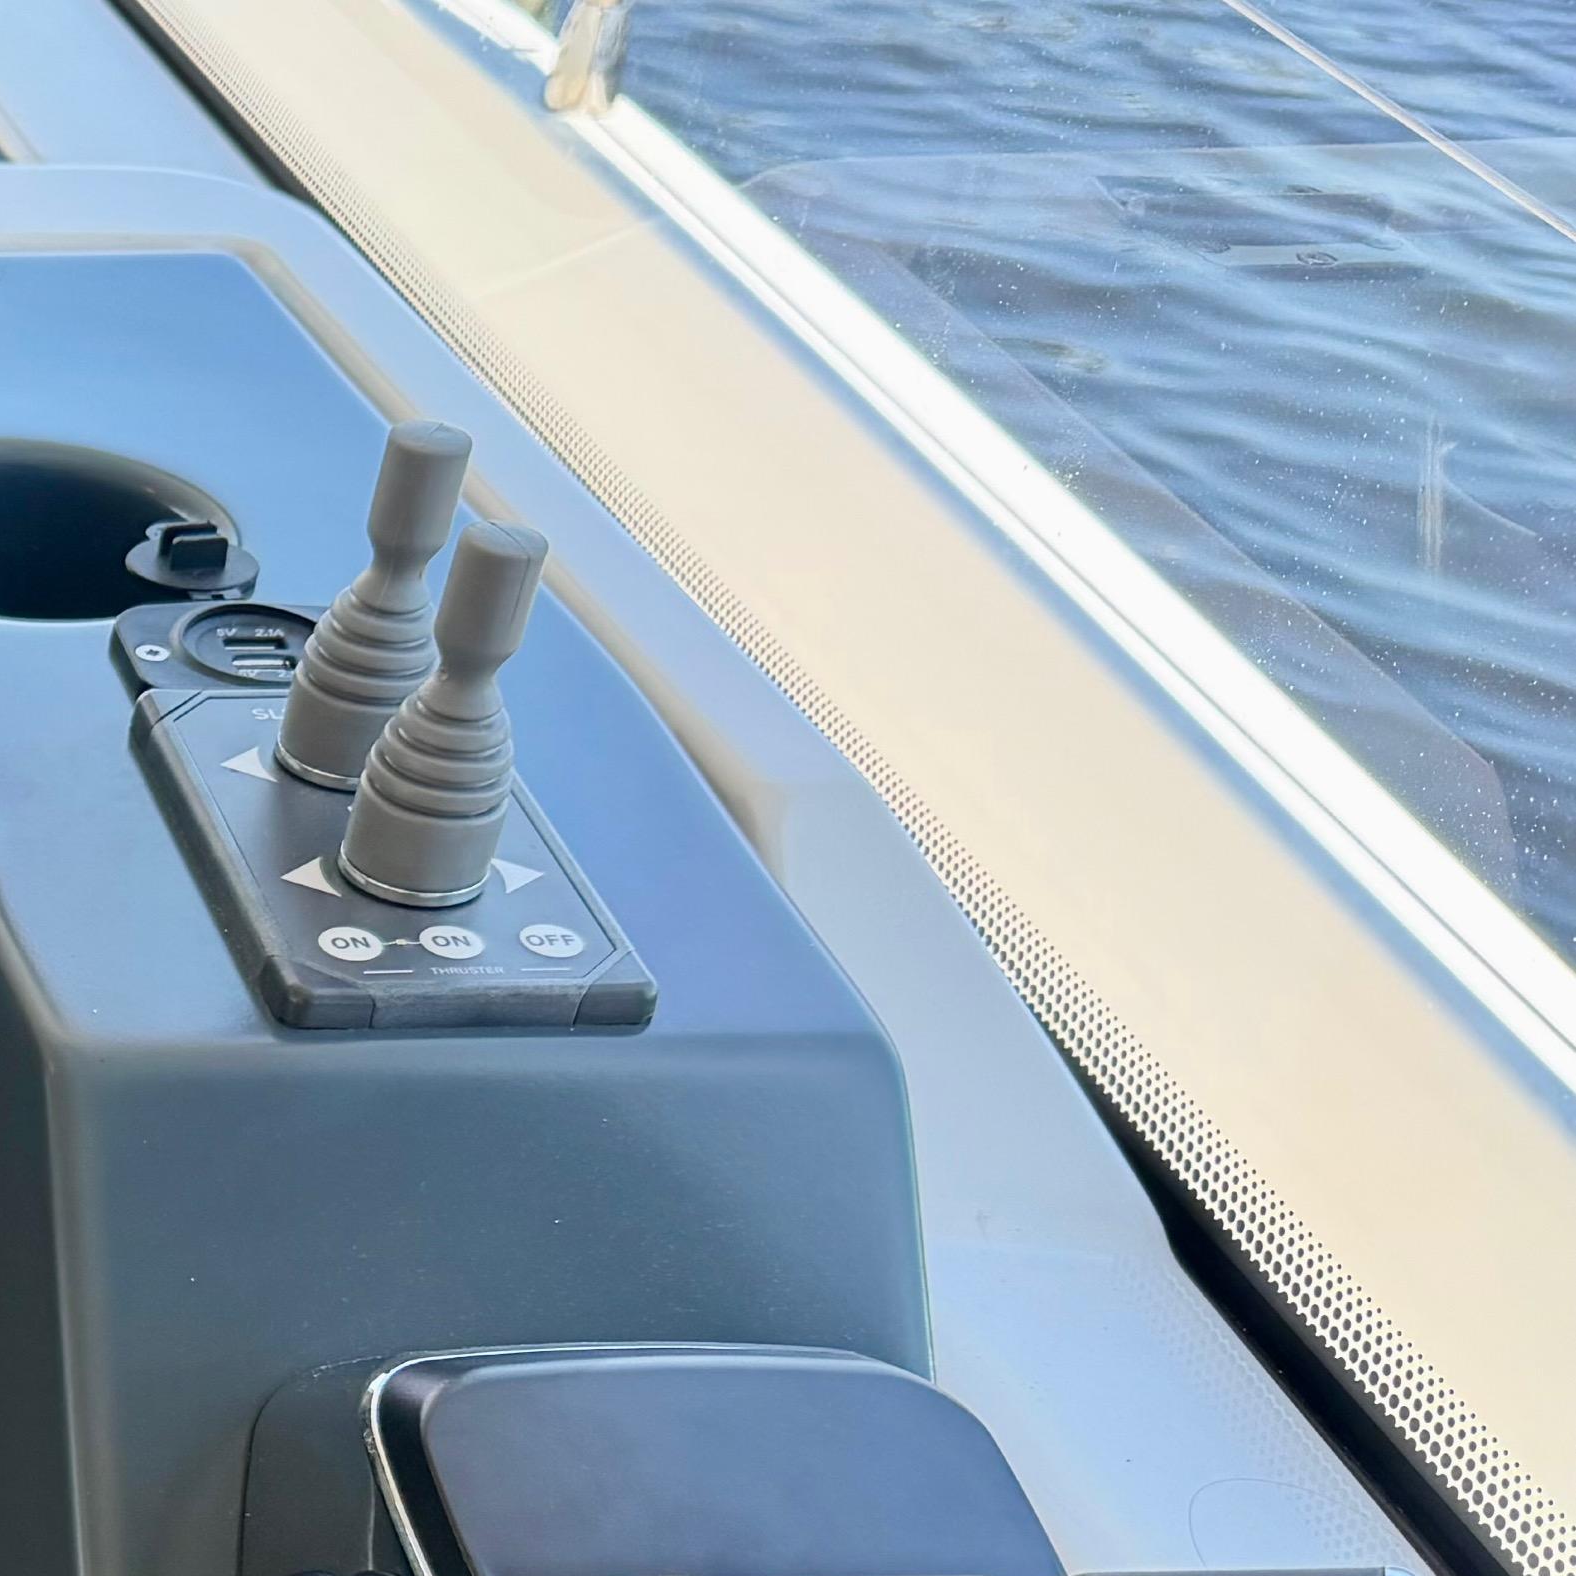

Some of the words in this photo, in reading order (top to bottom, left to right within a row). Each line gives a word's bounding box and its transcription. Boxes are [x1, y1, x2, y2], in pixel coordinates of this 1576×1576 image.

[254, 627, 285, 637] 2.1A
[331, 936, 372, 950] ON
[431, 935, 472, 948] ON
[526, 933, 576, 947] OFF
[430, 966, 505, 975] THRUSTER
